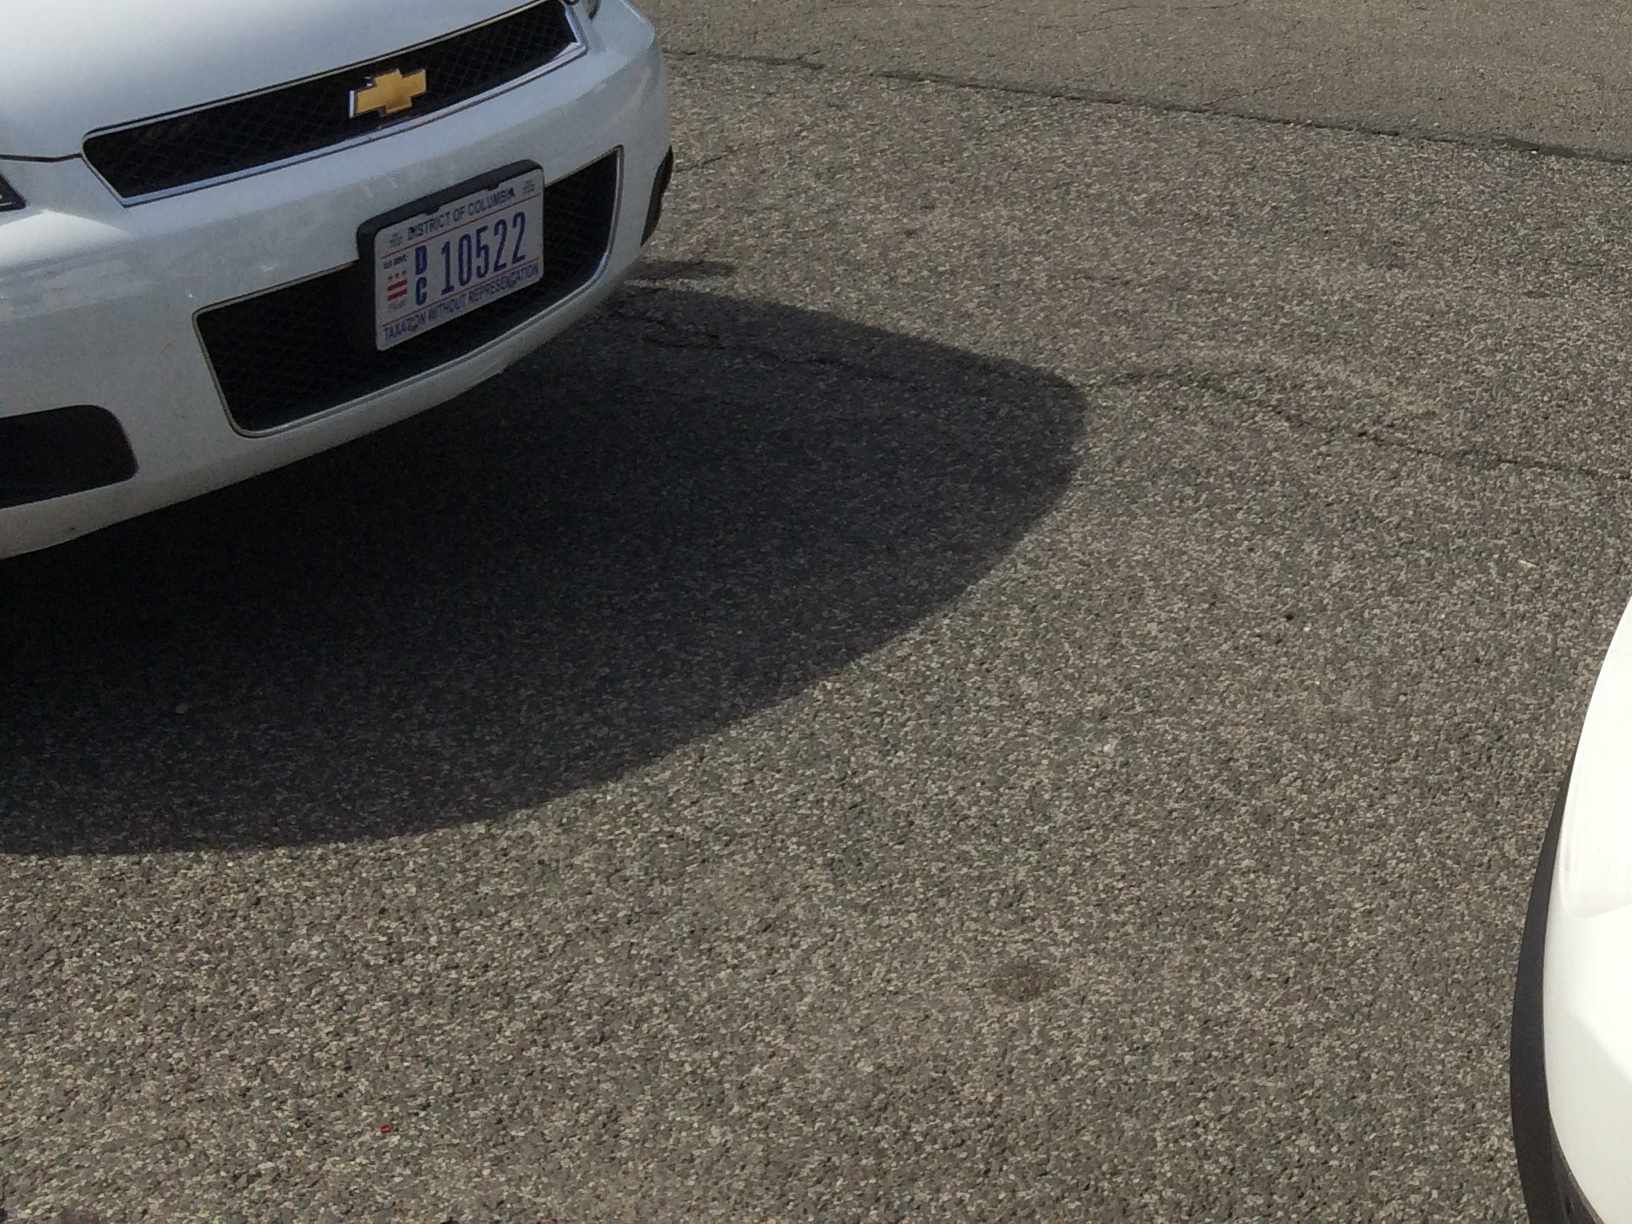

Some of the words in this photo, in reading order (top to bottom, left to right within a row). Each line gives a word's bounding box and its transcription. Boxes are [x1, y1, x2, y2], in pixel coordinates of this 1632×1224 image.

[407, 212, 450, 241] DISTRICT
[453, 206, 465, 223] OF
[468, 187, 516, 216] COLUMBIA
[441, 211, 526, 296] 10522
